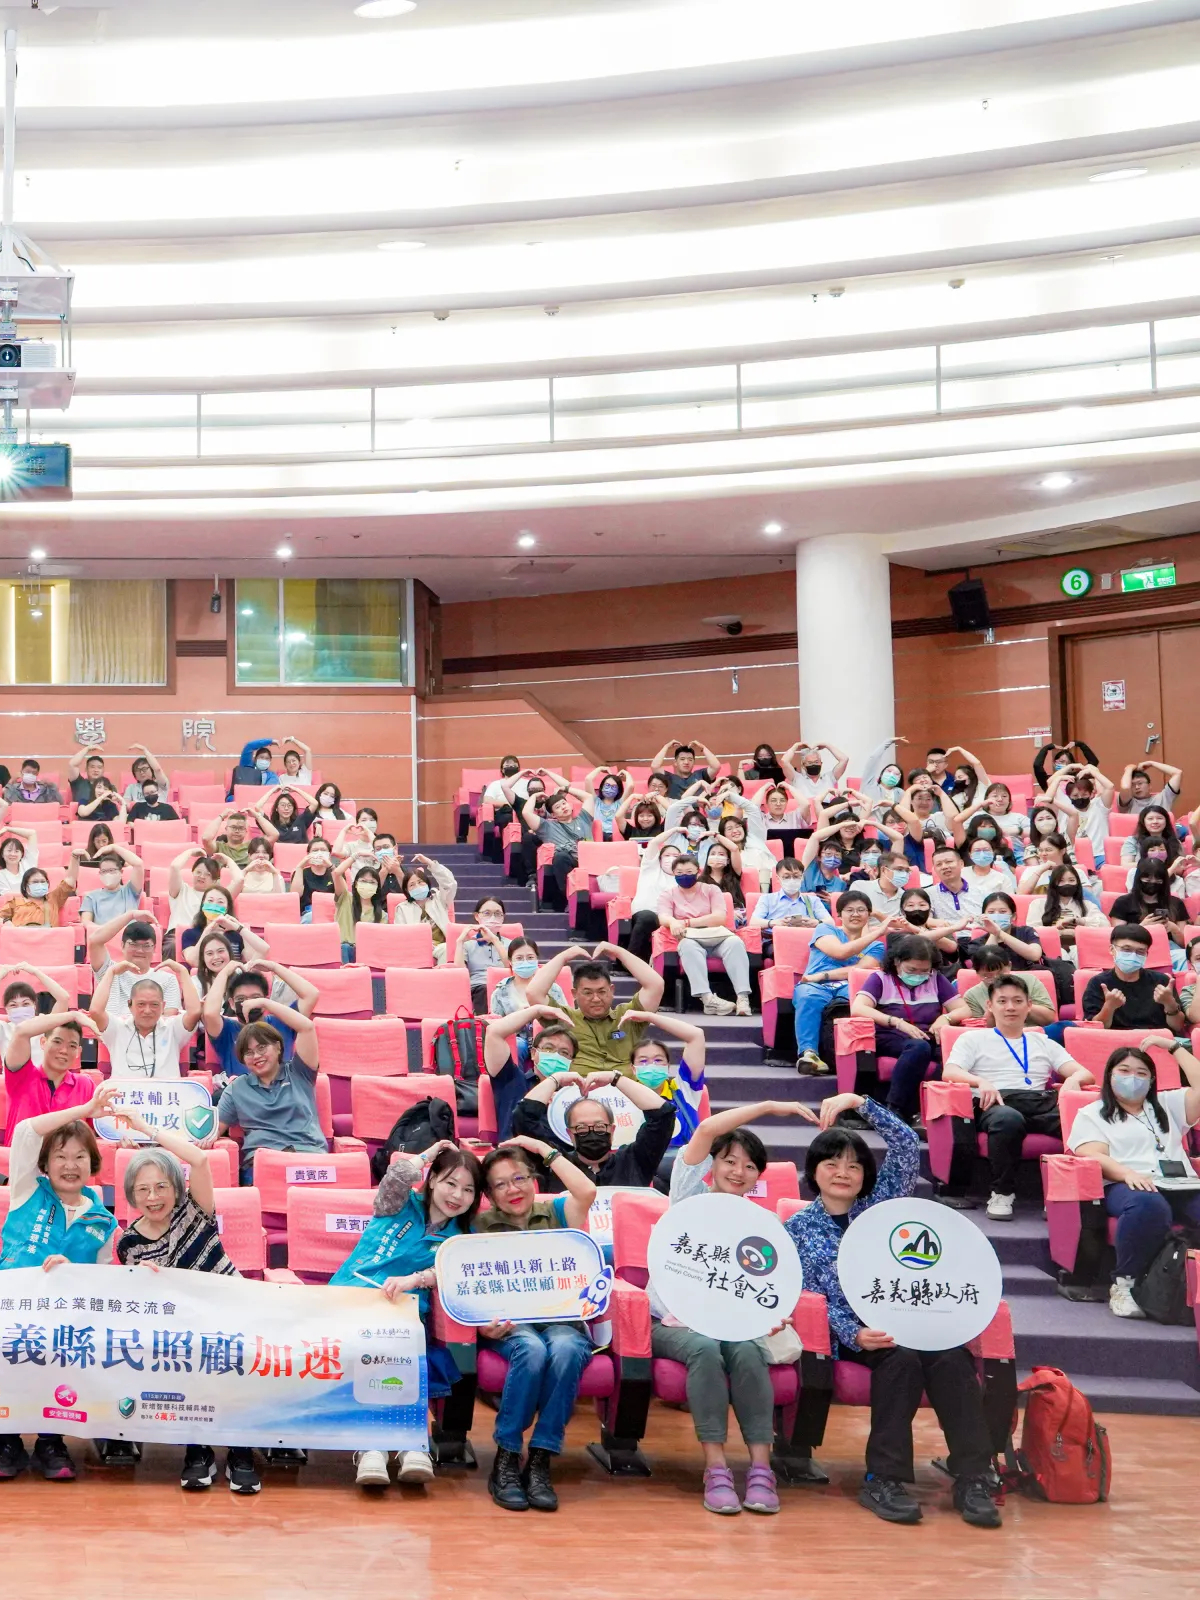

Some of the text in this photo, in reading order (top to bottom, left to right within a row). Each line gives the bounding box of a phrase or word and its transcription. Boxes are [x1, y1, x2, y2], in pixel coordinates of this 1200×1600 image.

[1070, 574, 1082, 590] 6
[294, 1170, 328, 1181] 貴賓席
[670, 1232, 731, 1268] 嘉義縣
[460, 1257, 577, 1278] 智慧輔具新上路
[682, 1270, 703, 1282] County
[456, 1274, 588, 1296] 嘉義縣民照顧加速
[706, 1268, 780, 1310] 社會局
[862, 1278, 980, 1306] 嘉義縣政府
